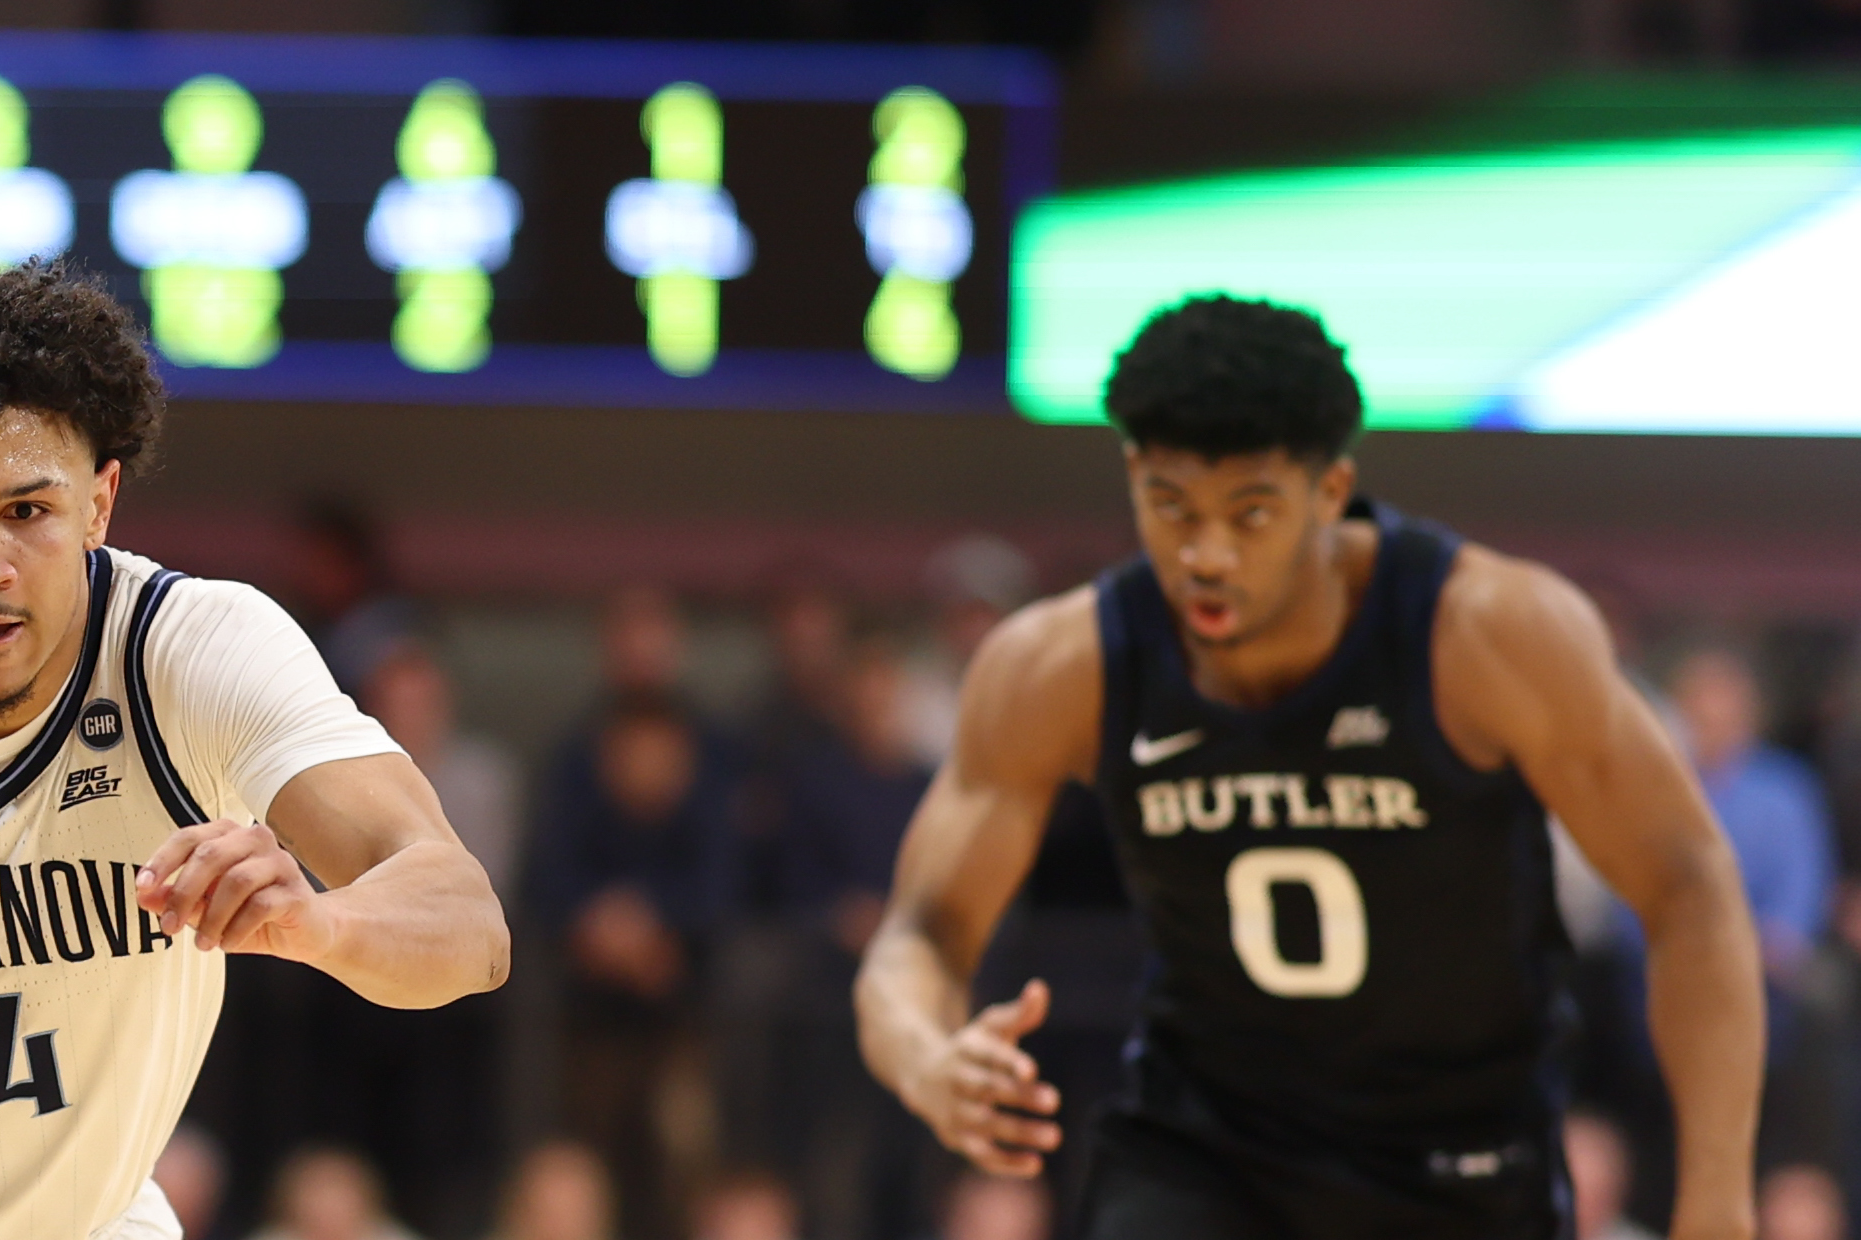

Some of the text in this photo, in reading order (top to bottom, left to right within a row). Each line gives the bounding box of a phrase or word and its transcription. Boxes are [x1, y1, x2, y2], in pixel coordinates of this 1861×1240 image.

[84, 714, 117, 737] GHR
[66, 765, 108, 788] BIG
[61, 778, 123, 803] EAST
[1139, 773, 1428, 836] BUTLER
[1225, 845, 1369, 999] 0
